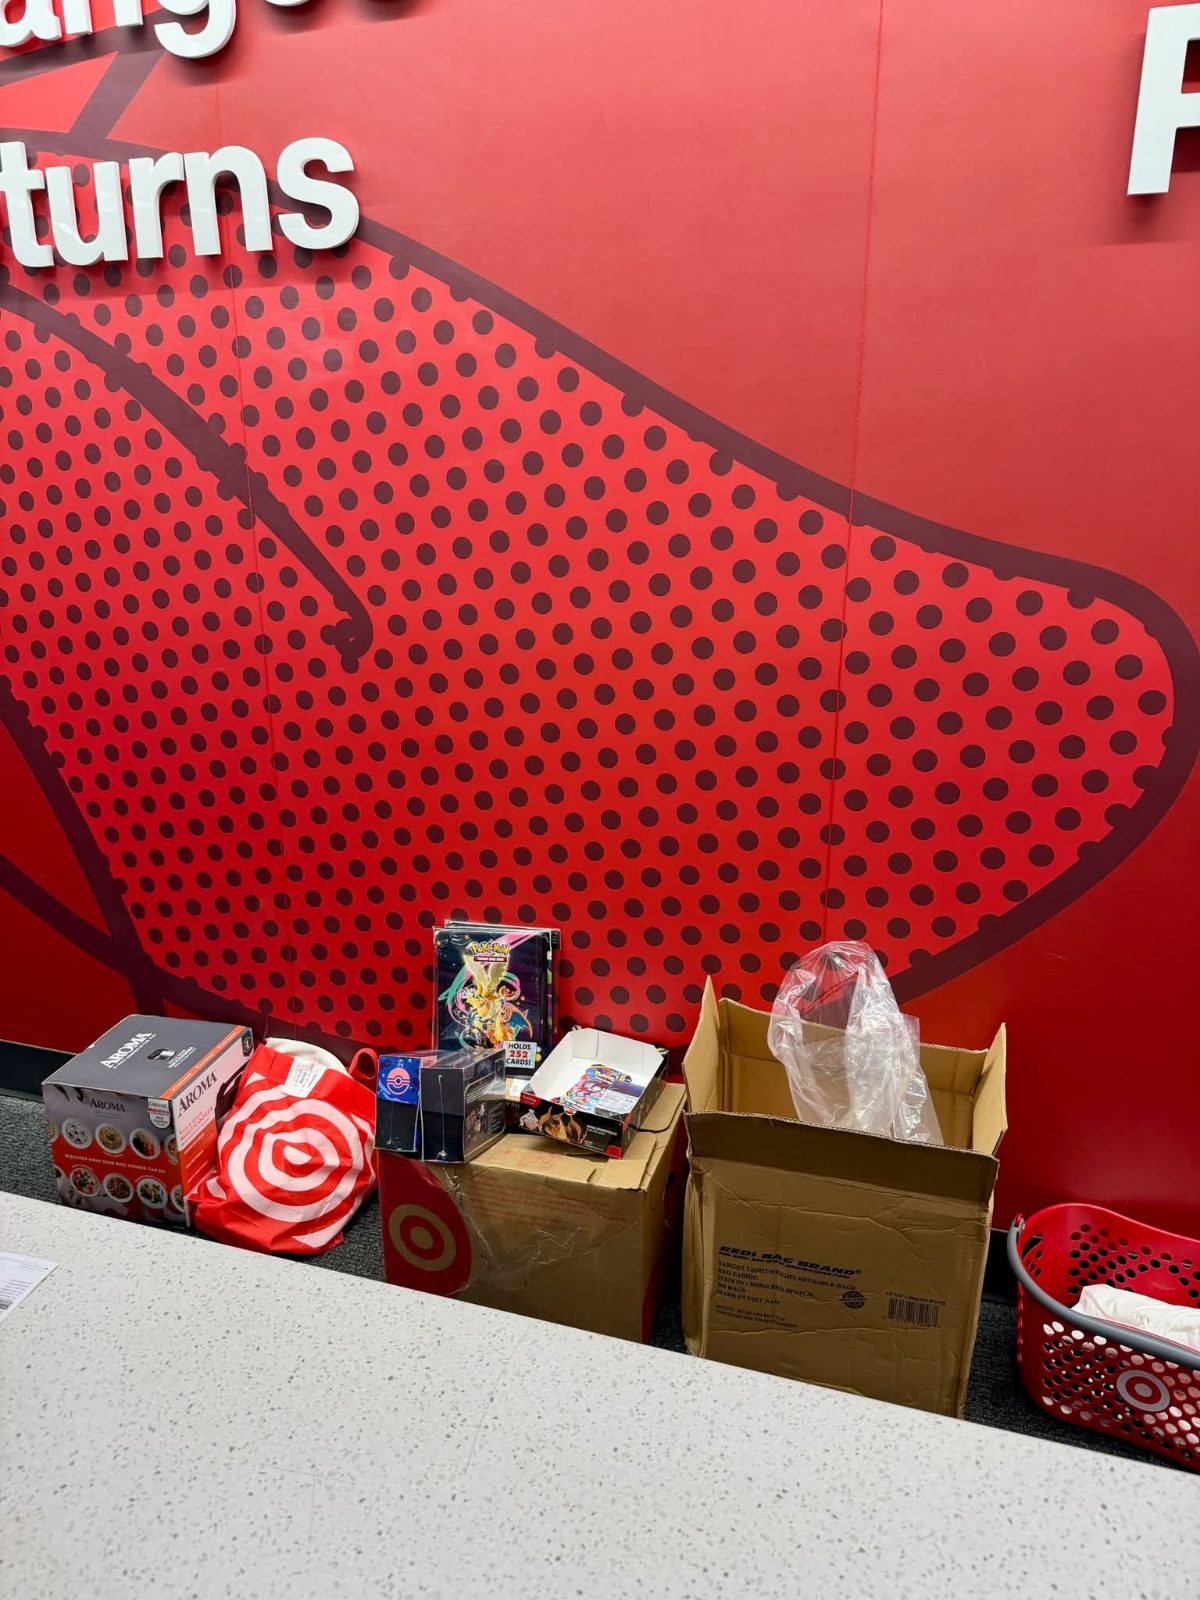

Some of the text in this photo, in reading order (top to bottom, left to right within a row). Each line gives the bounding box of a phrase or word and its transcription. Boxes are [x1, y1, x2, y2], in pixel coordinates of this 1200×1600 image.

[100, 1032, 153, 1069] AROMA
[509, 1051, 529, 1059] 252
[506, 1058, 532, 1066] CARDS!
[178, 1071, 217, 1118] AROMA
[89, 1099, 126, 1112] AROMA
[719, 1246, 757, 1257] REDI
[761, 1253, 793, 1264] BAG
